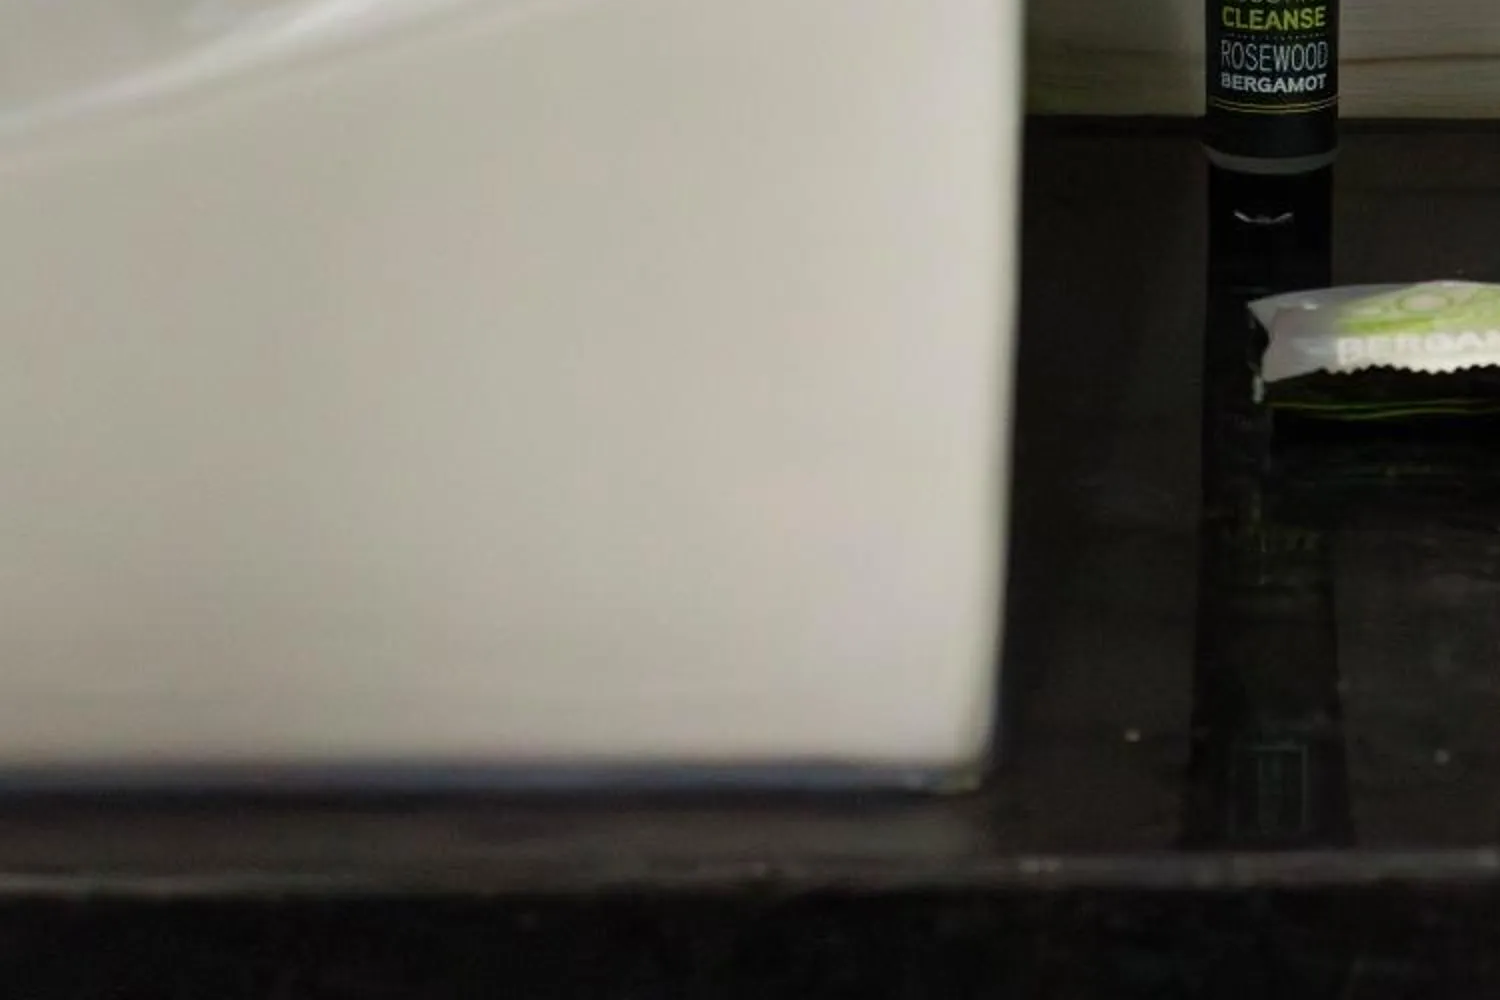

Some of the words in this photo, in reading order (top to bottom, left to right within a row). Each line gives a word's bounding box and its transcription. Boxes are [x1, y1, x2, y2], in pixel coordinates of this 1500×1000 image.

[1222, 6, 1326, 31] CLEANSE
[1221, 39, 1329, 73] ROSEWOOD
[1220, 72, 1327, 94] BERGAMOT
